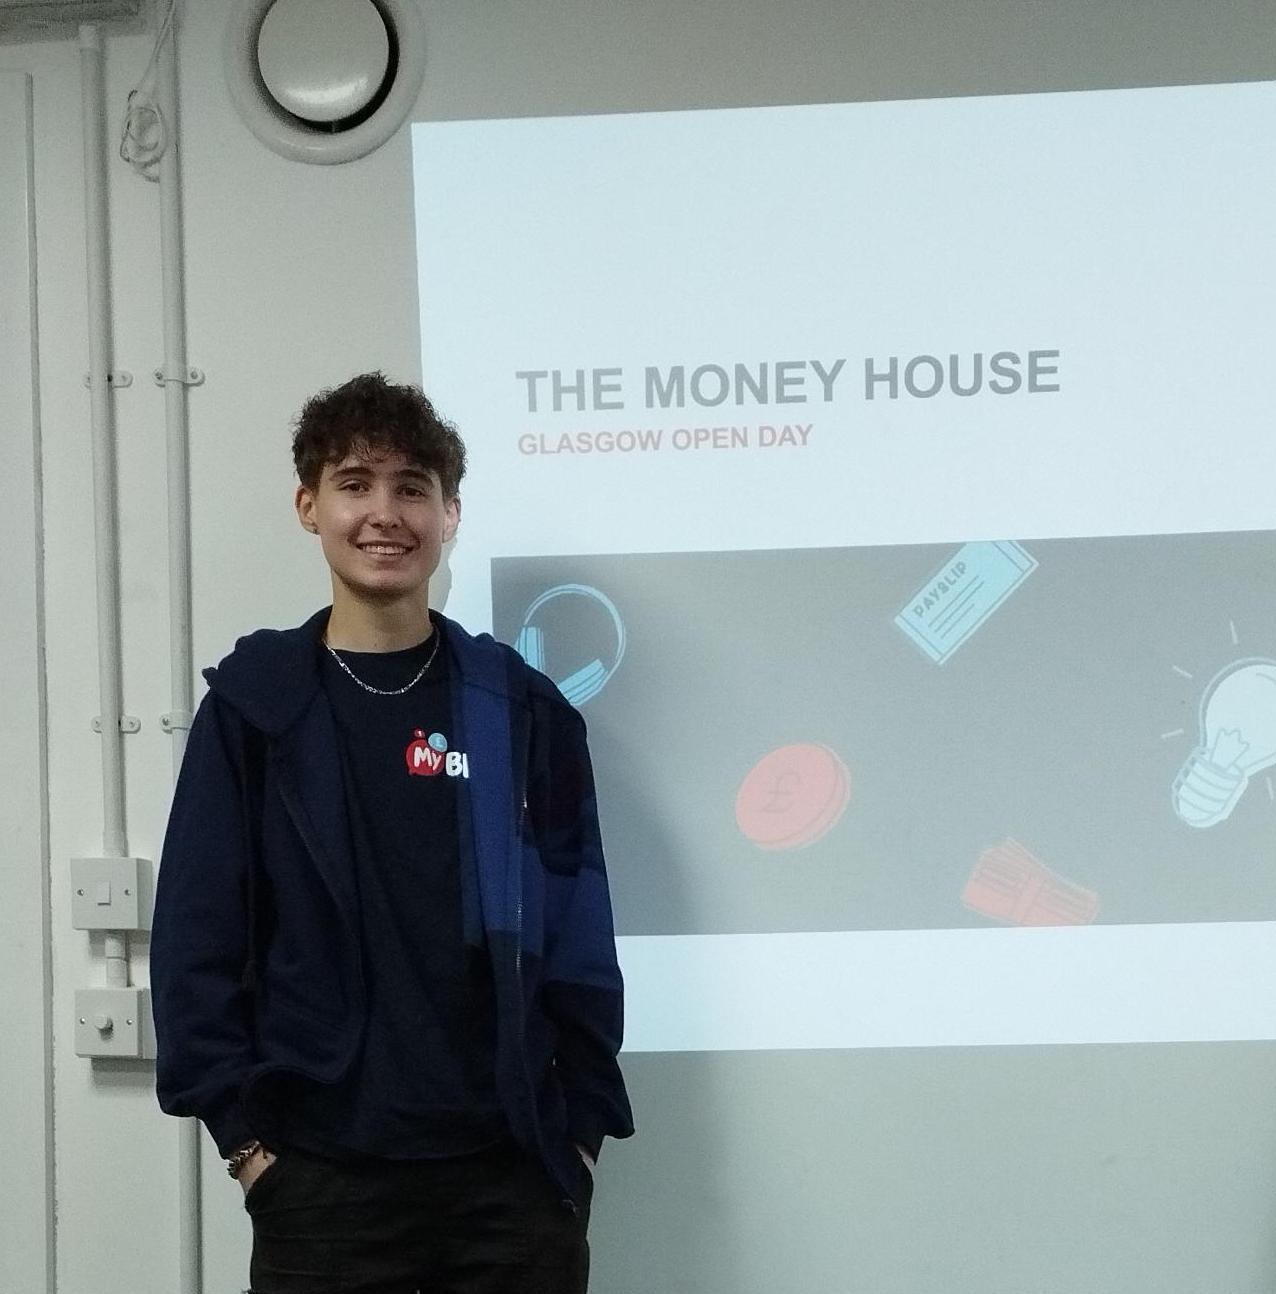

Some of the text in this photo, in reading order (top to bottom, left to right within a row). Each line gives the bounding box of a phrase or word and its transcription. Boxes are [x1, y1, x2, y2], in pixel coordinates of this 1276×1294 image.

[515, 349, 1061, 413] THE MONEY HOUSE
[517, 424, 814, 456] GLASGOW OPEN DAY
